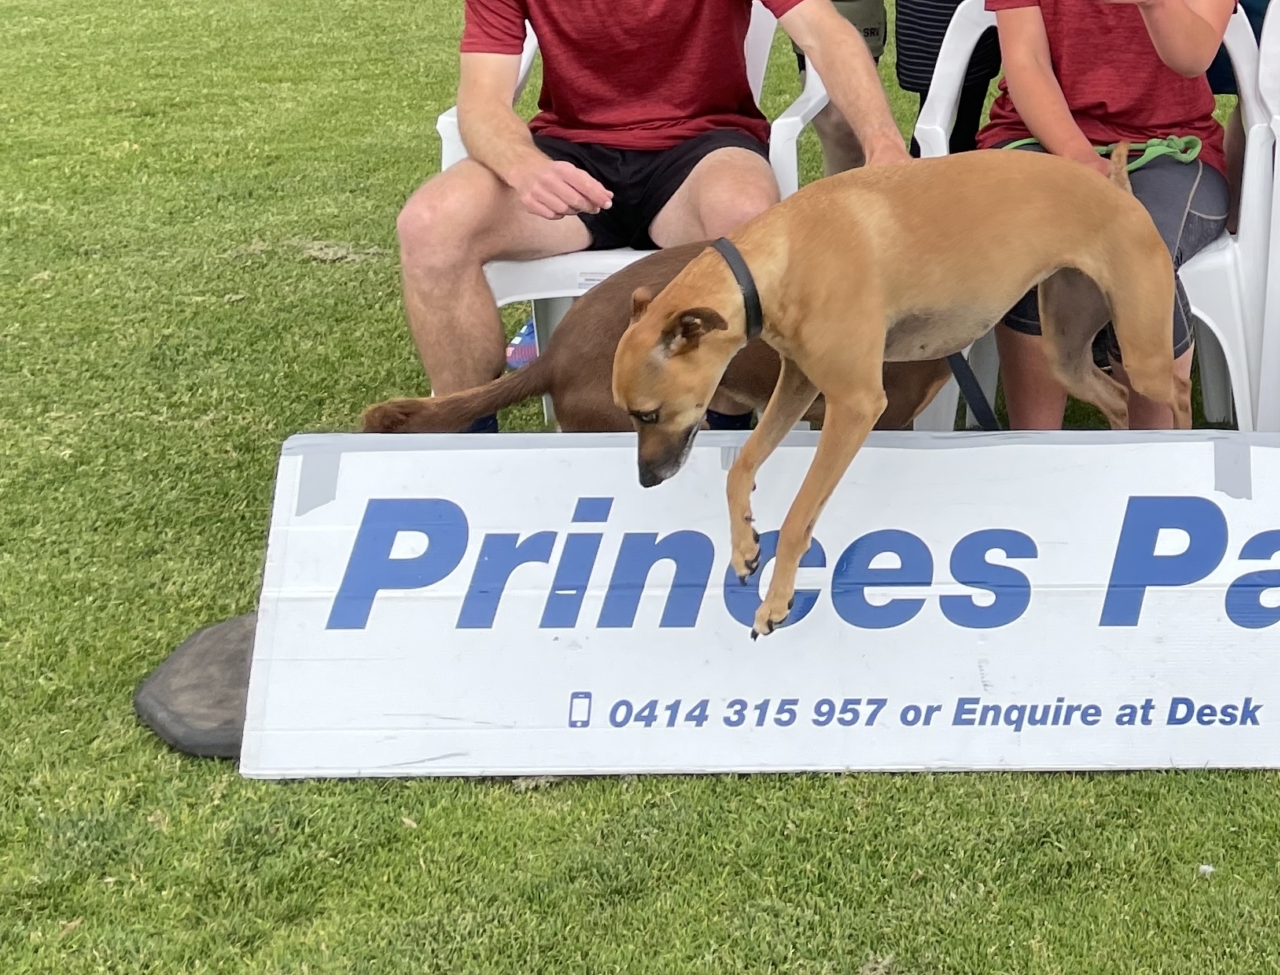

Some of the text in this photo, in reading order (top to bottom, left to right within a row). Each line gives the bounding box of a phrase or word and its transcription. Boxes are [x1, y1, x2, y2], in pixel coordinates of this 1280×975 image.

[326, 497, 1039, 630] Princes
[608, 697, 1264, 732] 0414 315 957 or Enquire at Desk
